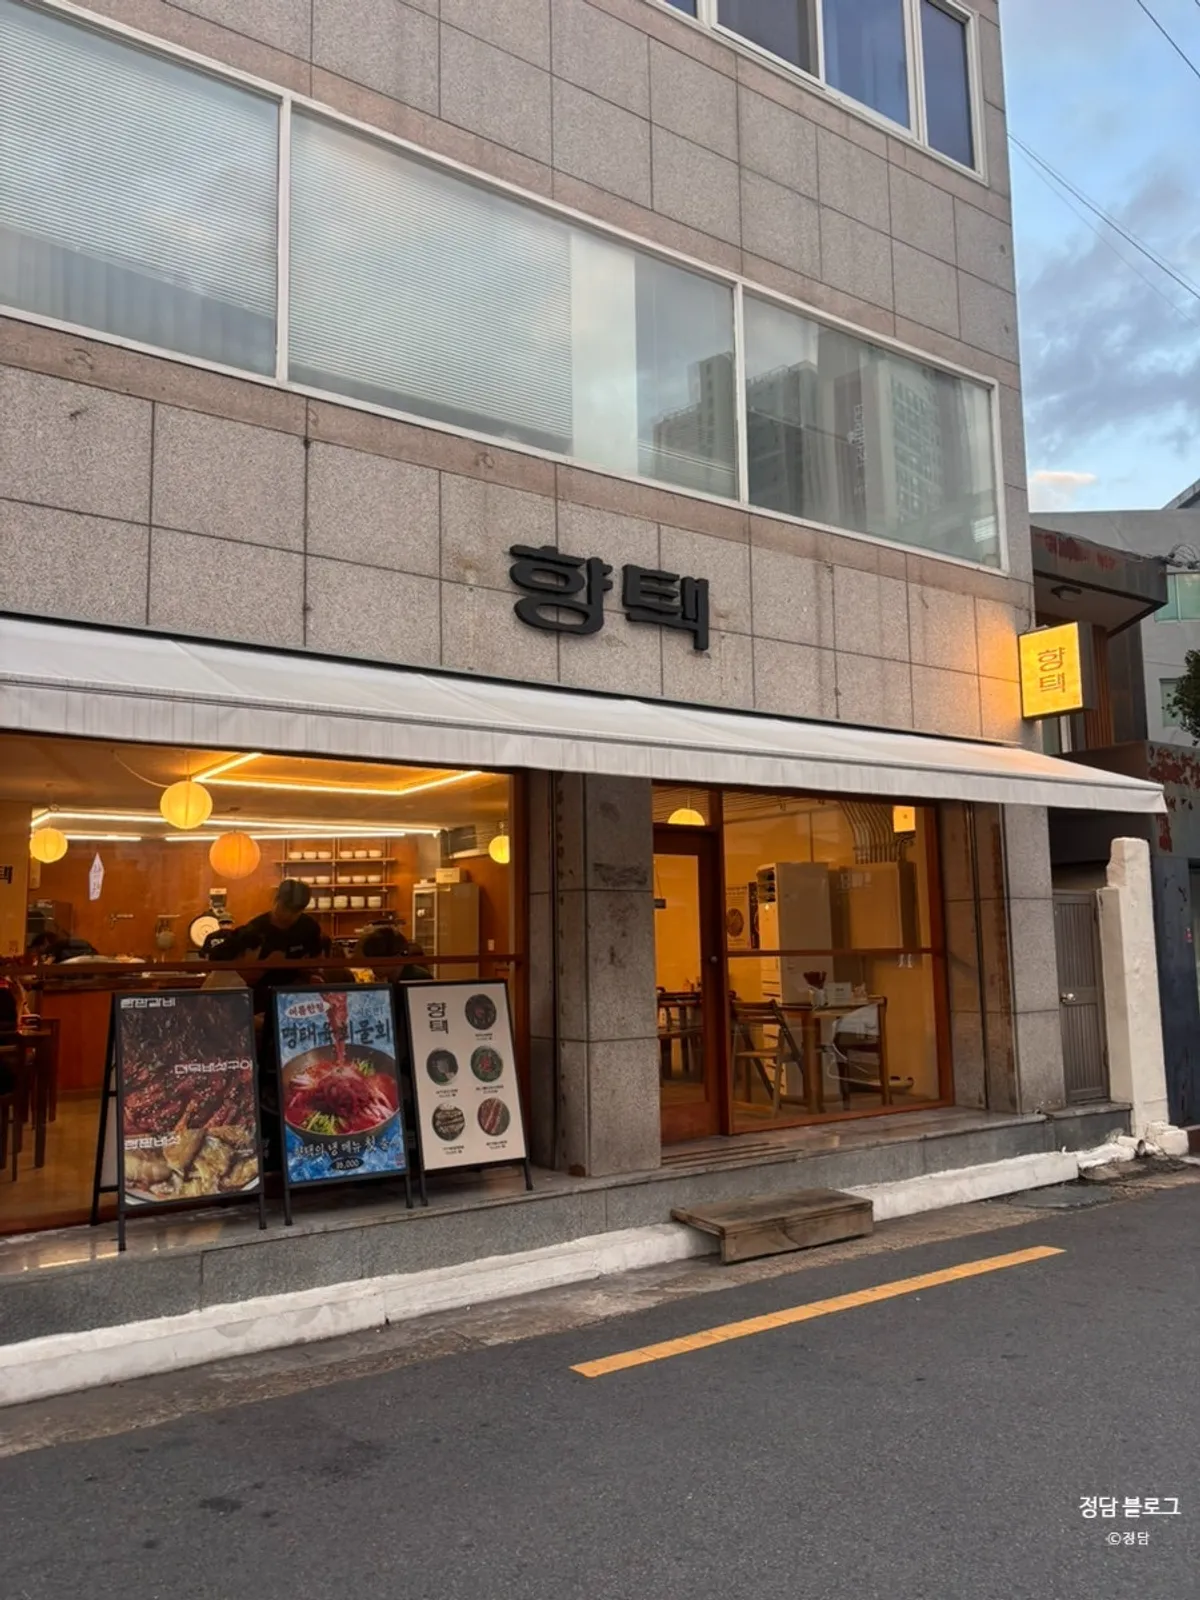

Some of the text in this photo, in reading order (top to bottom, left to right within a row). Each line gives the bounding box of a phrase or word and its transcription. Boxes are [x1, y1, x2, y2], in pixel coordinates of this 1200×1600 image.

[509, 544, 709, 650] 향택
[1037, 646, 1066, 693] 향택
[427, 1002, 449, 1034] 향택
